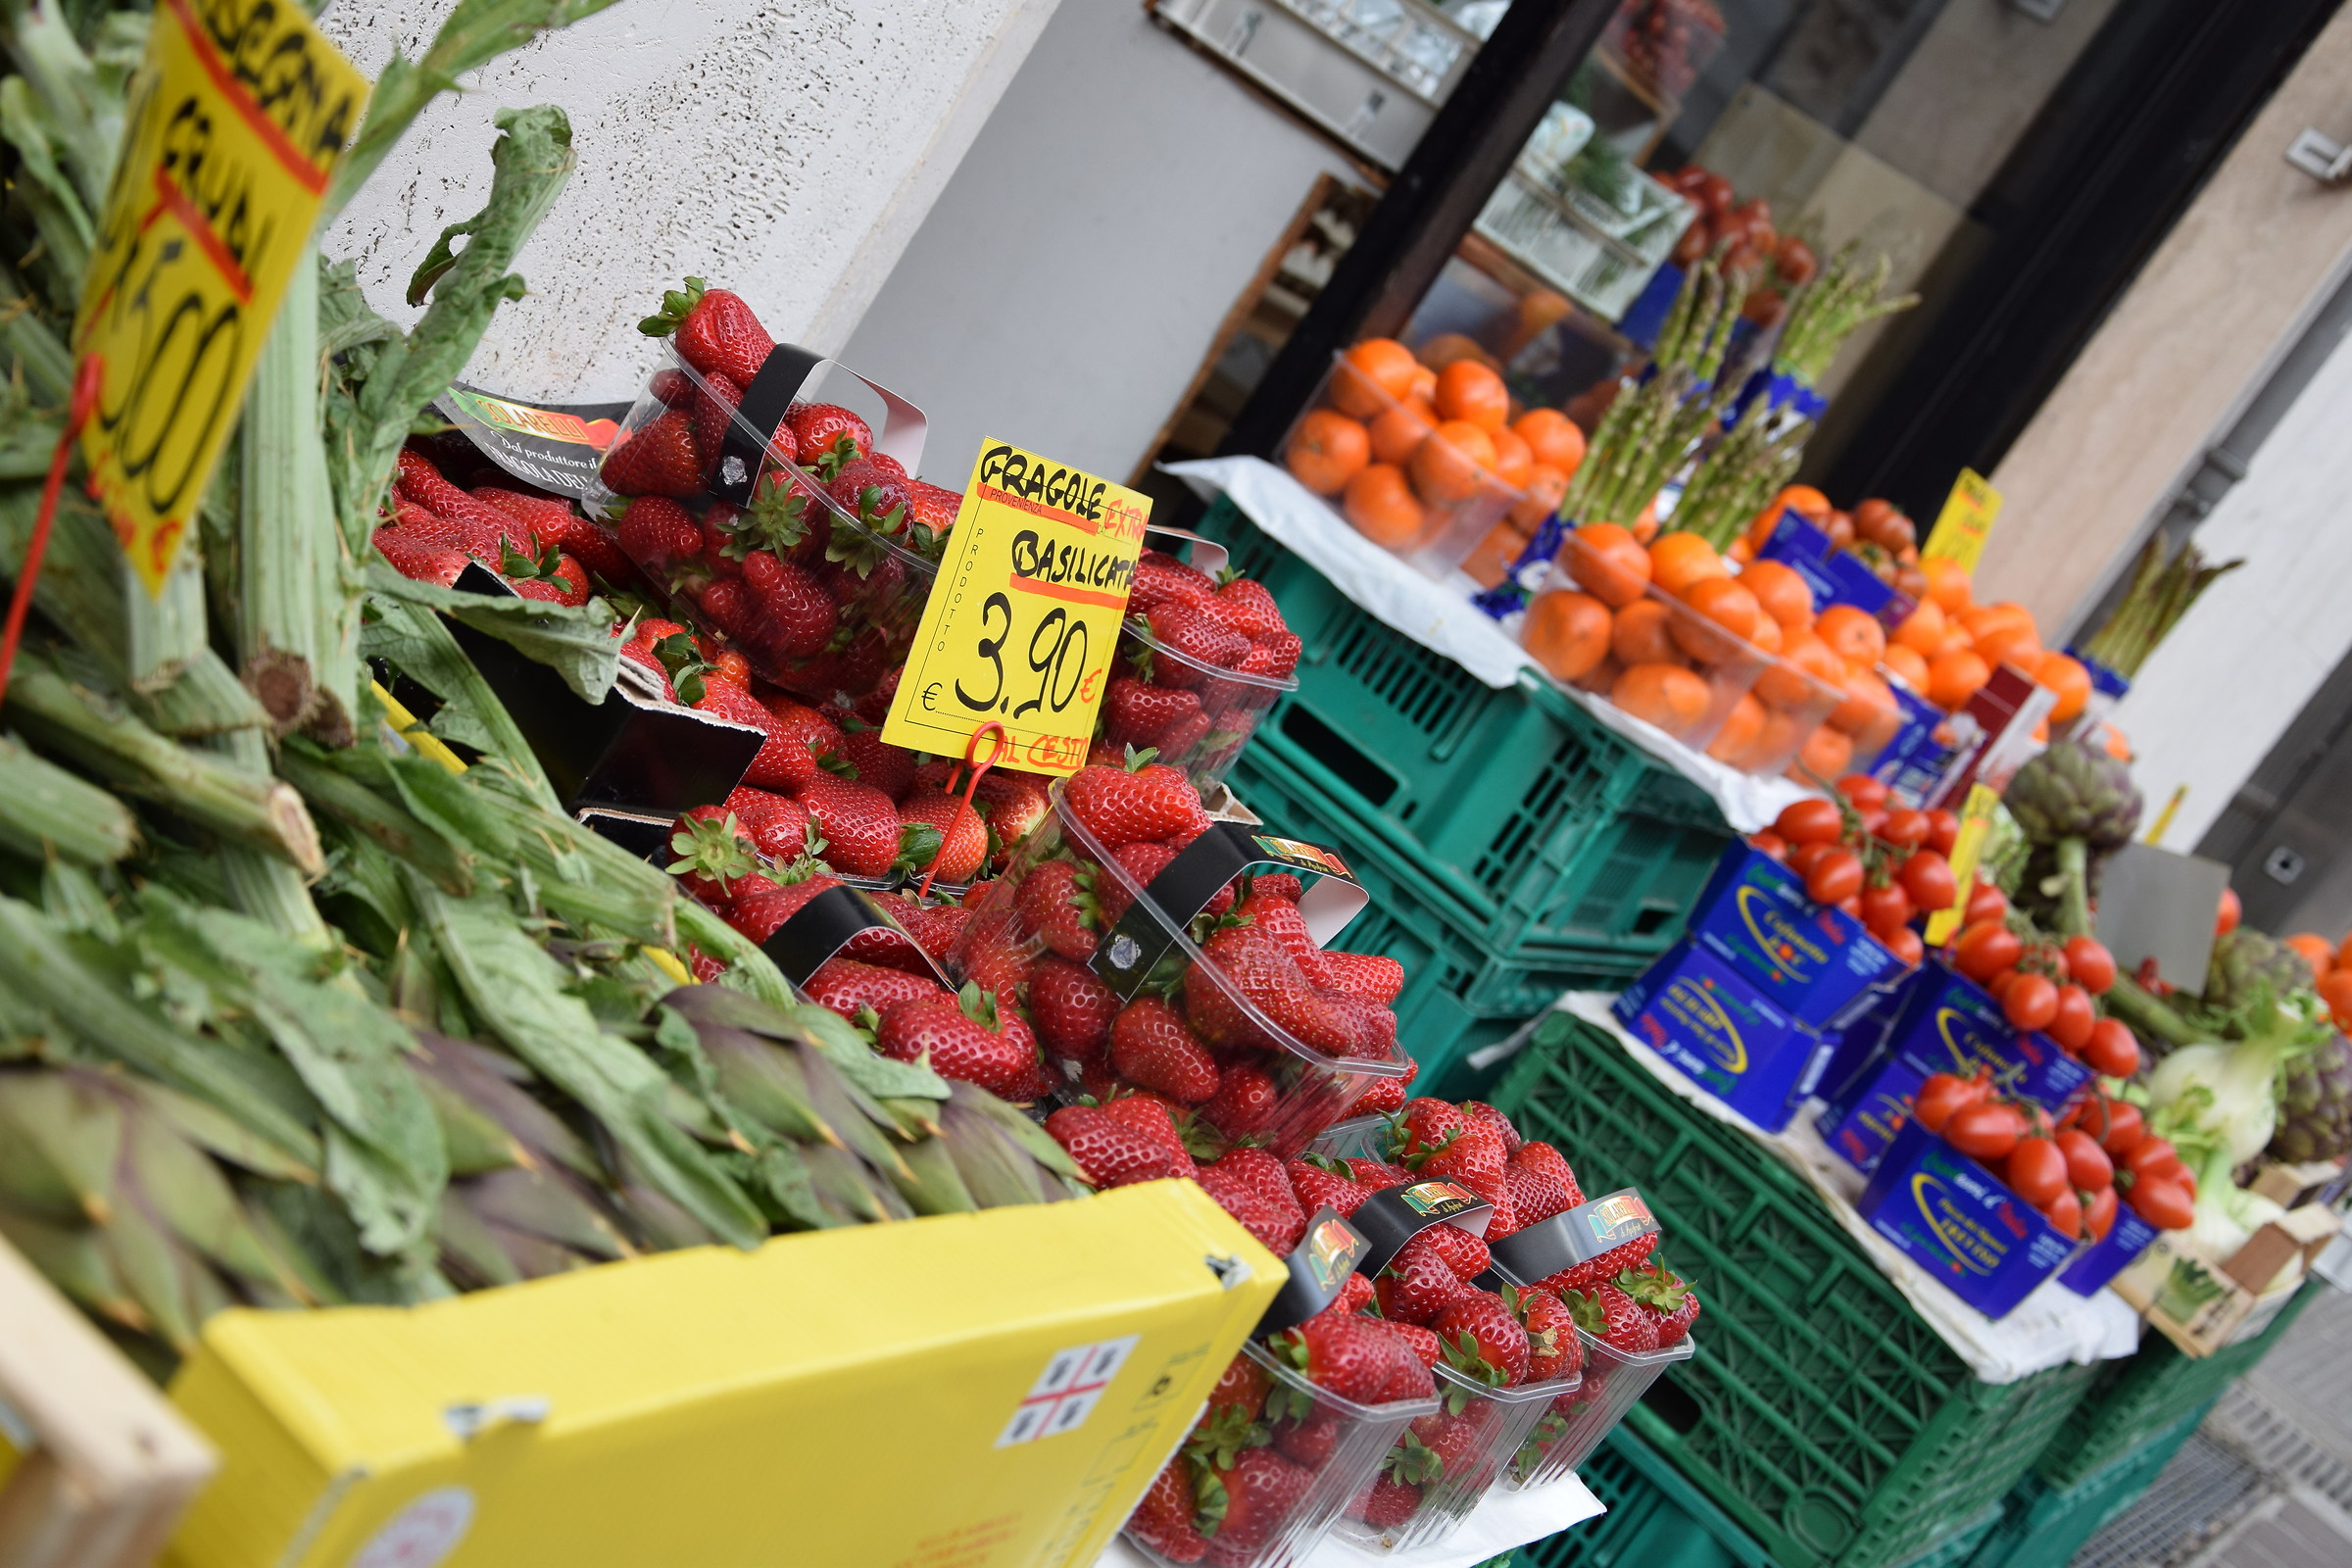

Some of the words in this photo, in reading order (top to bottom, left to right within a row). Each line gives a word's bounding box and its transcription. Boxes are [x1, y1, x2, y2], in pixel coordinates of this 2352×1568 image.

[476, 399, 588, 440] SOLARELLI
[484, 441, 561, 484] FRAGOLA
[490, 430, 522, 453] Dal
[524, 451, 588, 469] produttore
[980, 446, 1105, 520] FRAGOLE
[989, 488, 1042, 514] PROVENIENZA
[1011, 529, 1137, 592] BASILICATA
[937, 527, 984, 652] PRODOTTO
[921, 682, 943, 711] €
[955, 591, 1088, 719] 3.90
[1080, 668, 1102, 704] €
[1000, 735, 1020, 763] AL
[1026, 734, 1089, 770] CESTO
